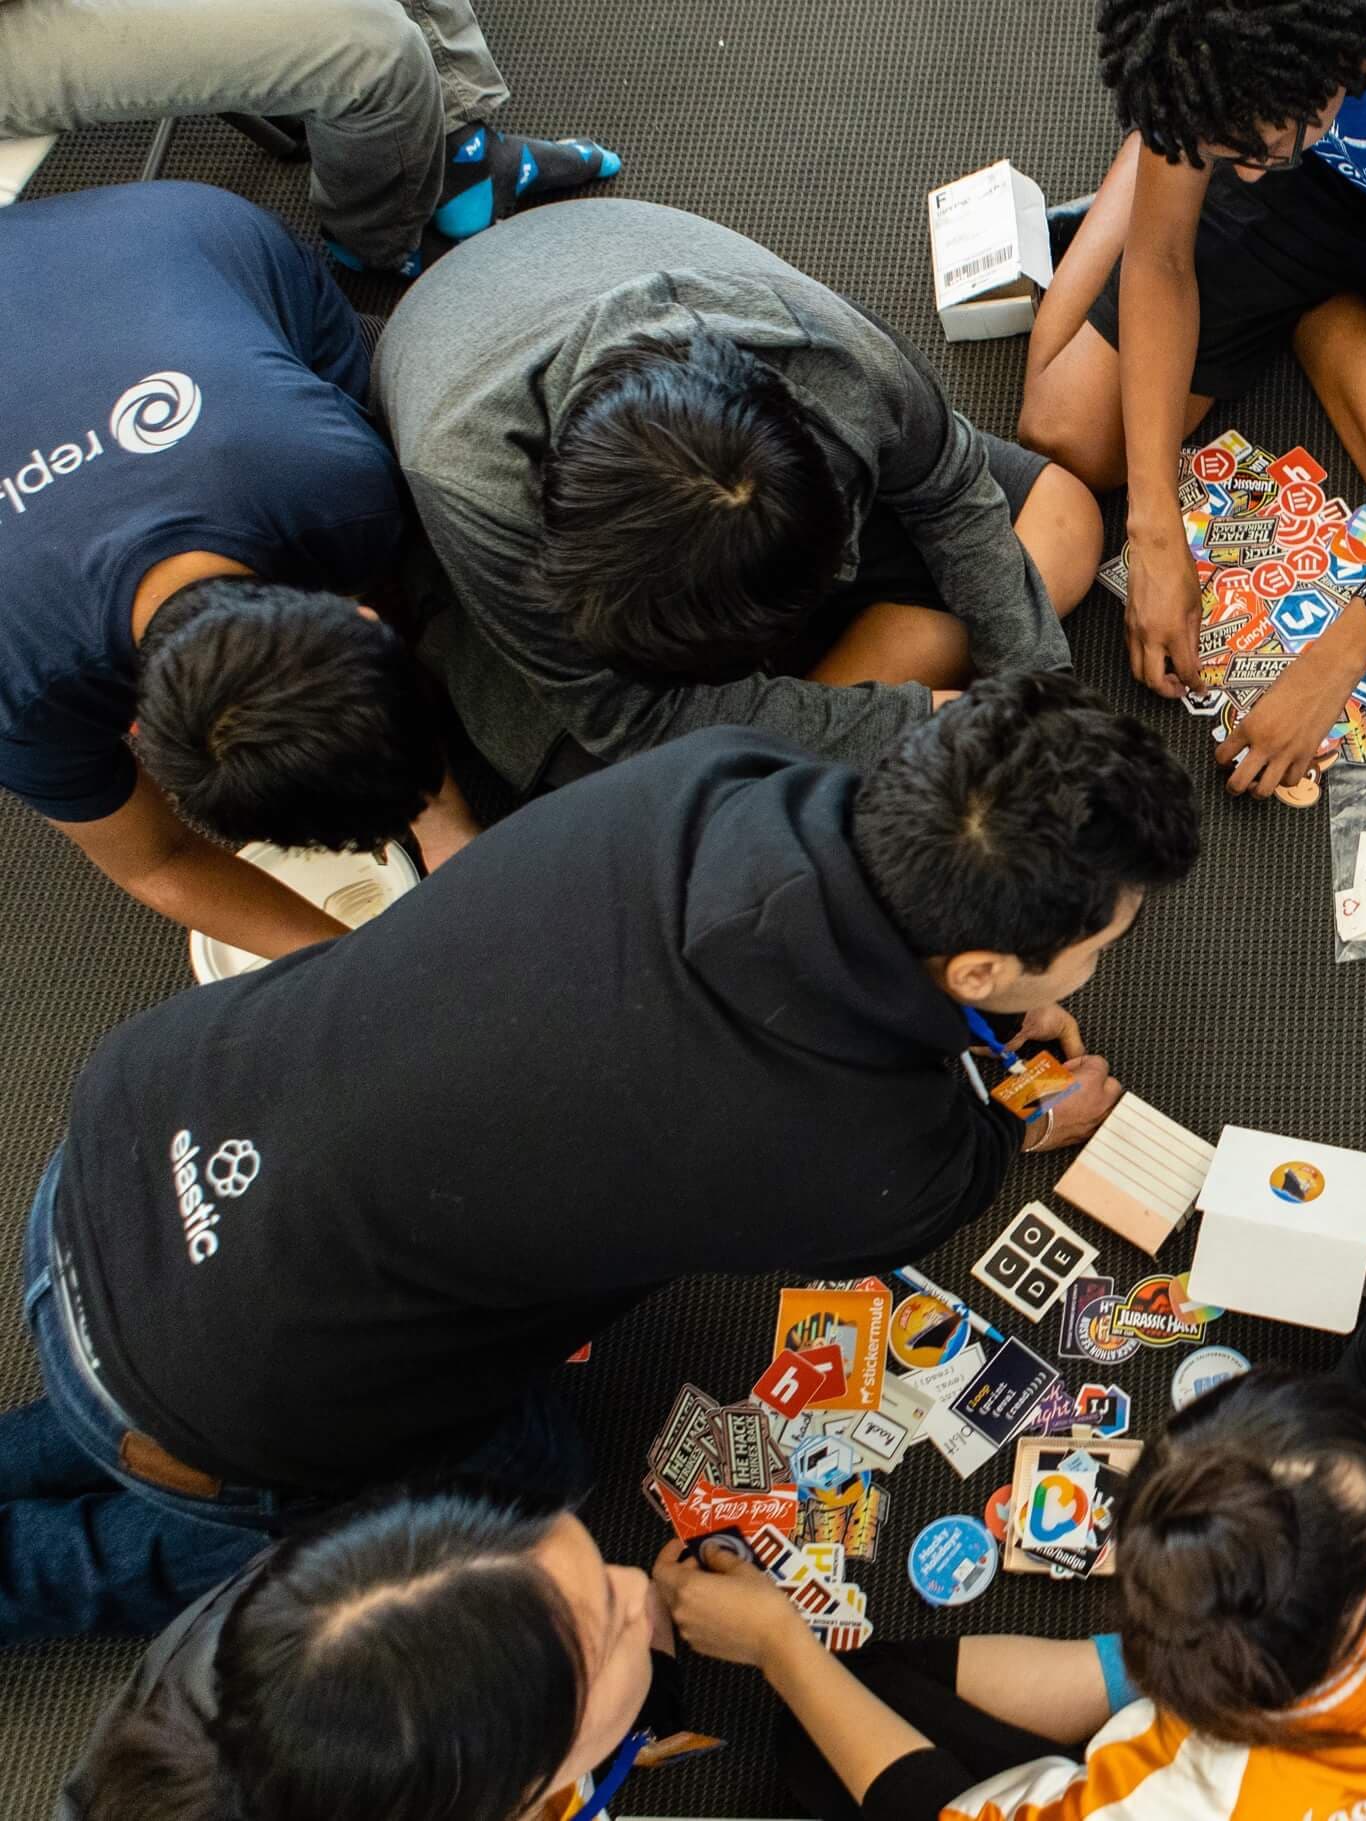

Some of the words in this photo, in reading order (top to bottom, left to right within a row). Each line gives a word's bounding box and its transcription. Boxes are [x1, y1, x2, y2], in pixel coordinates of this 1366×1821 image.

[0, 430, 104, 513] repl
[1210, 531, 1246, 543] HACK
[1247, 529, 1271, 542] THE
[1234, 660, 1258, 672] THE
[170, 1129, 221, 1265] elastic
[1117, 1309, 1167, 1330] JURASSIC
[862, 1296, 885, 1388] stickermule
[732, 1414, 750, 1453] HACK
[663, 1451, 688, 1480] THE
[734, 1461, 751, 1487] THE
[714, 1500, 749, 1521] Club
[750, 1499, 794, 1521] Hack
